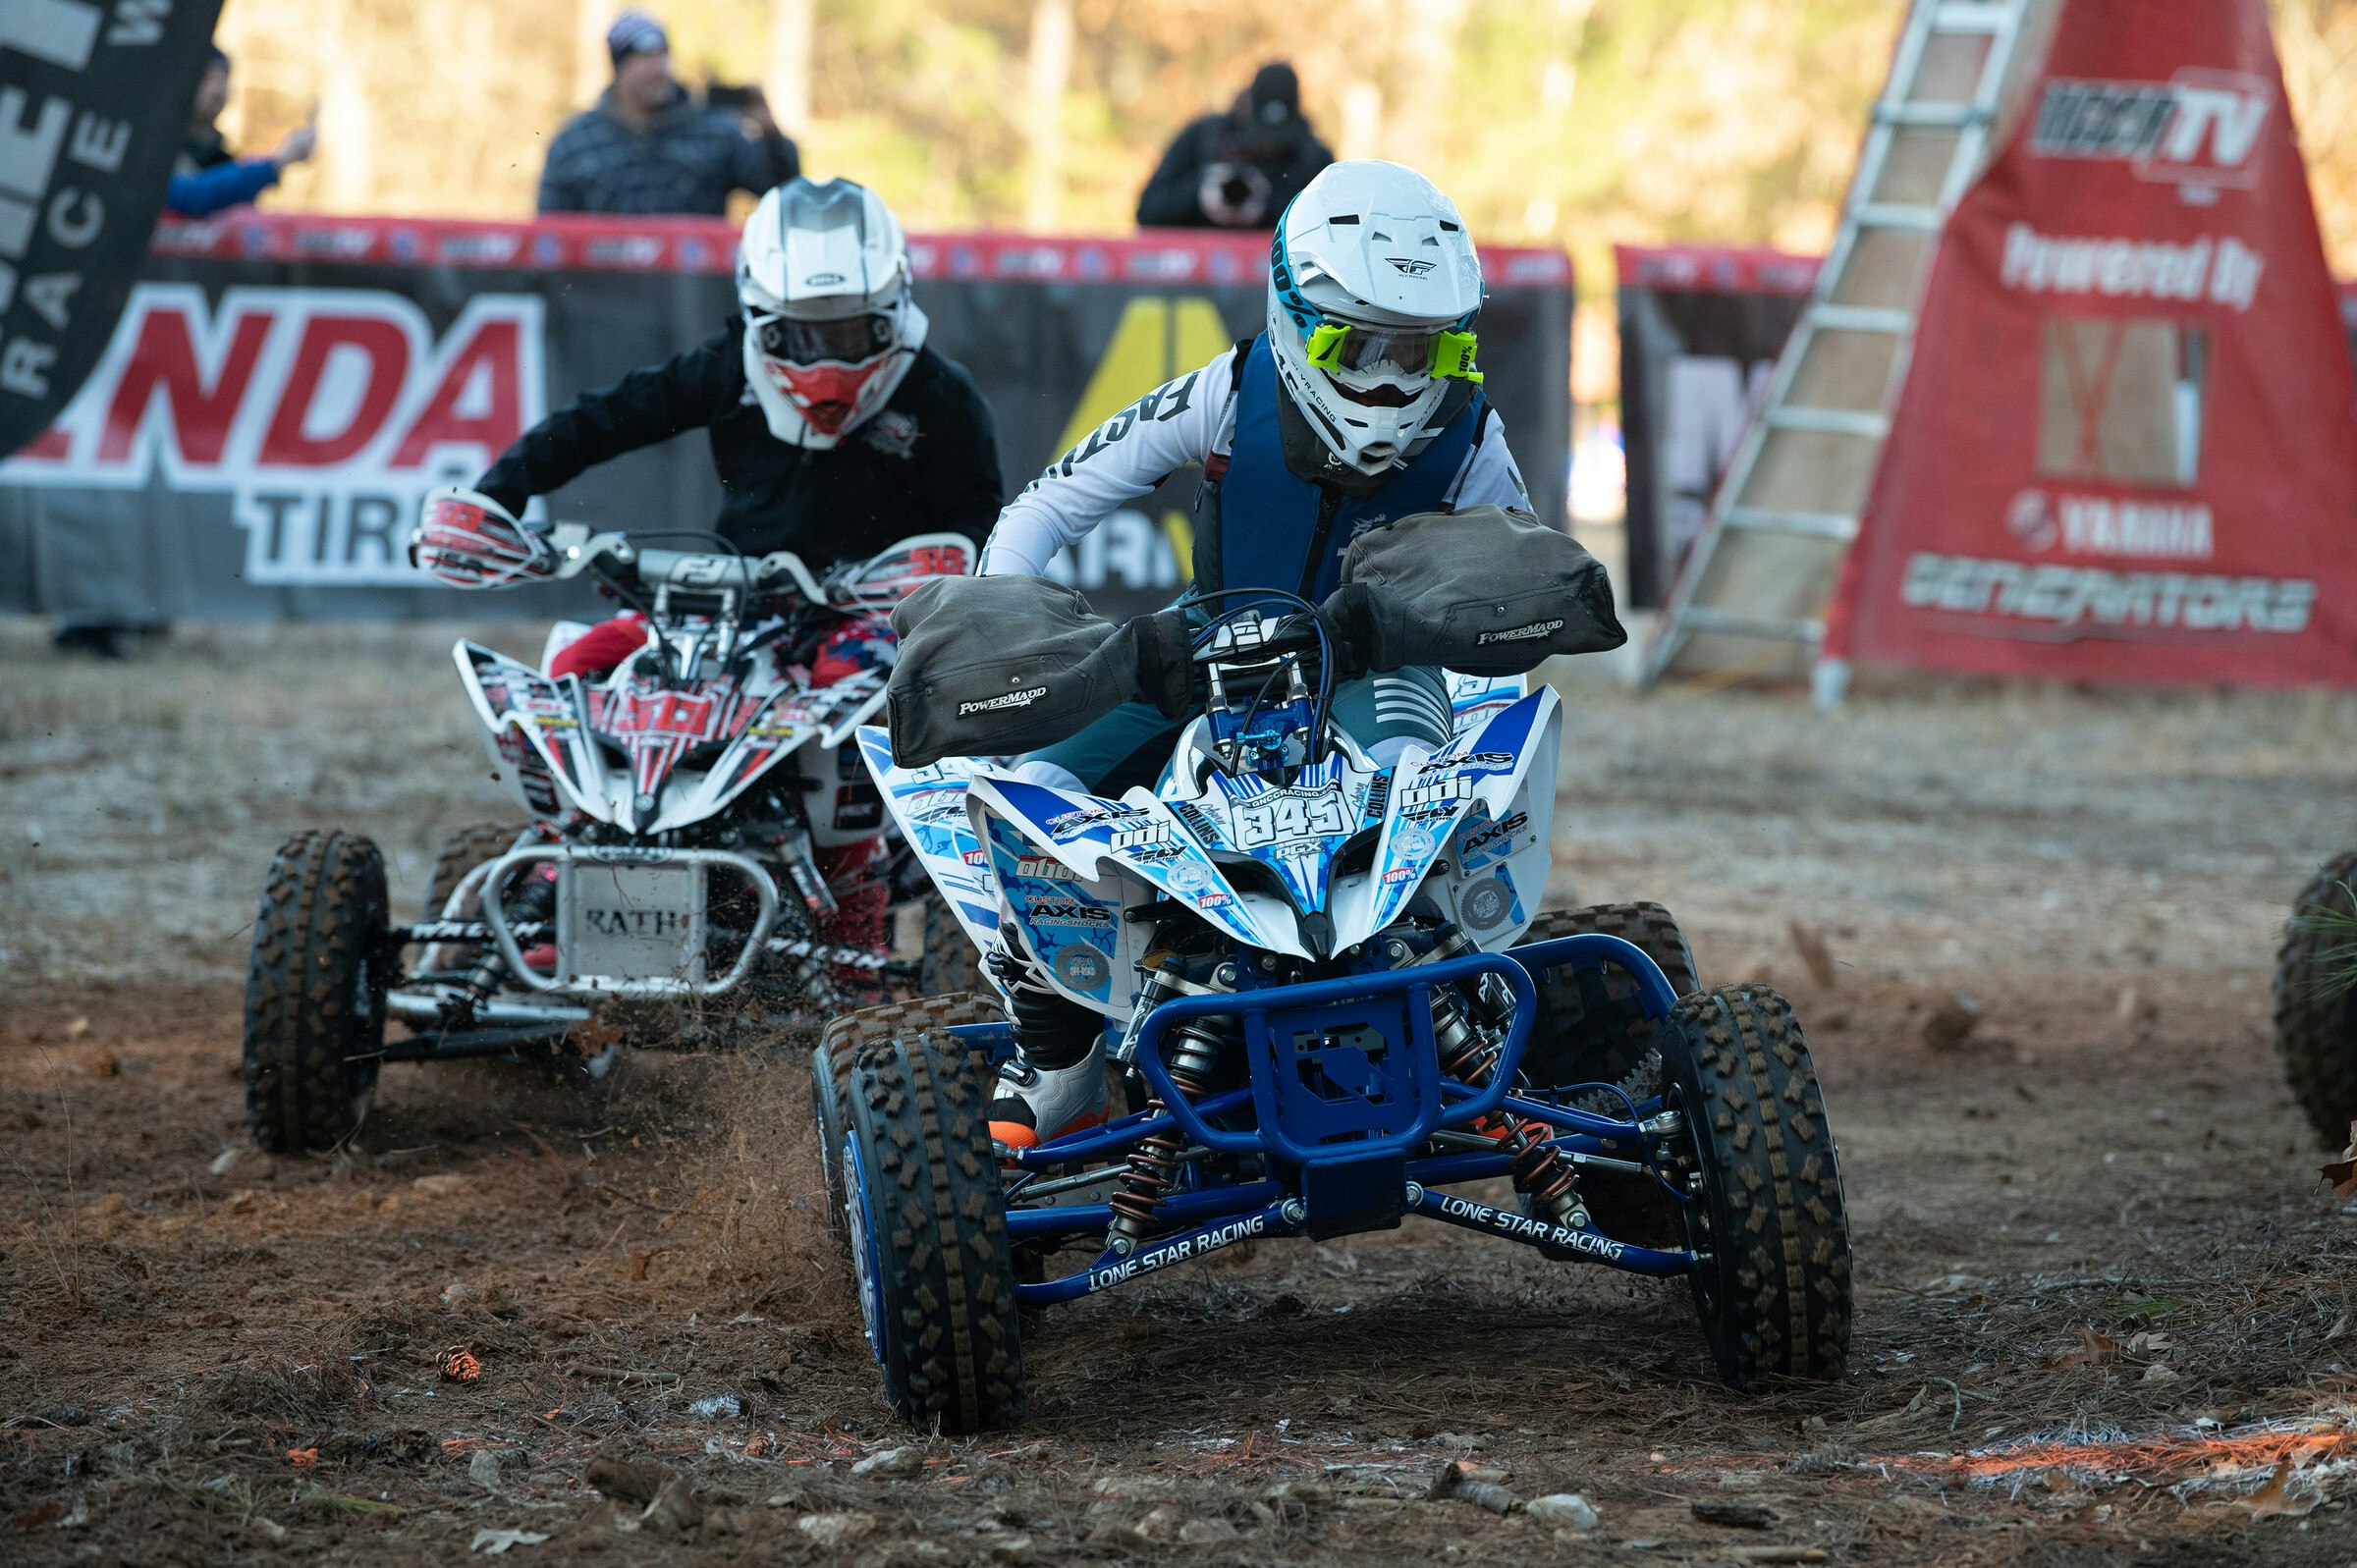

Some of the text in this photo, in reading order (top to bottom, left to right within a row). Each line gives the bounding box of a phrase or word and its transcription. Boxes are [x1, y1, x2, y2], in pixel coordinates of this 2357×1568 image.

[2001, 224, 2263, 311] Powered By
[1457, 345, 1473, 373] 100%
[15, 306, 525, 466] NDA
[1417, 752, 1514, 776] AXIS
[1242, 790, 1344, 846] 345
[1366, 774, 1390, 820] COLLINS
[1051, 807, 1151, 835] AXIS
[1178, 803, 1222, 846] COLLINS
[1462, 811, 1529, 855] AXIS
[1385, 870, 1416, 884] 100%
[1025, 894, 1075, 905] CUSTOM
[1030, 904, 1111, 921] AXIS
[1200, 894, 1232, 908] 100%
[1440, 1196, 1625, 1262] LONE STAR RACING
[1088, 1215, 1265, 1293] LONE STAR RACING
